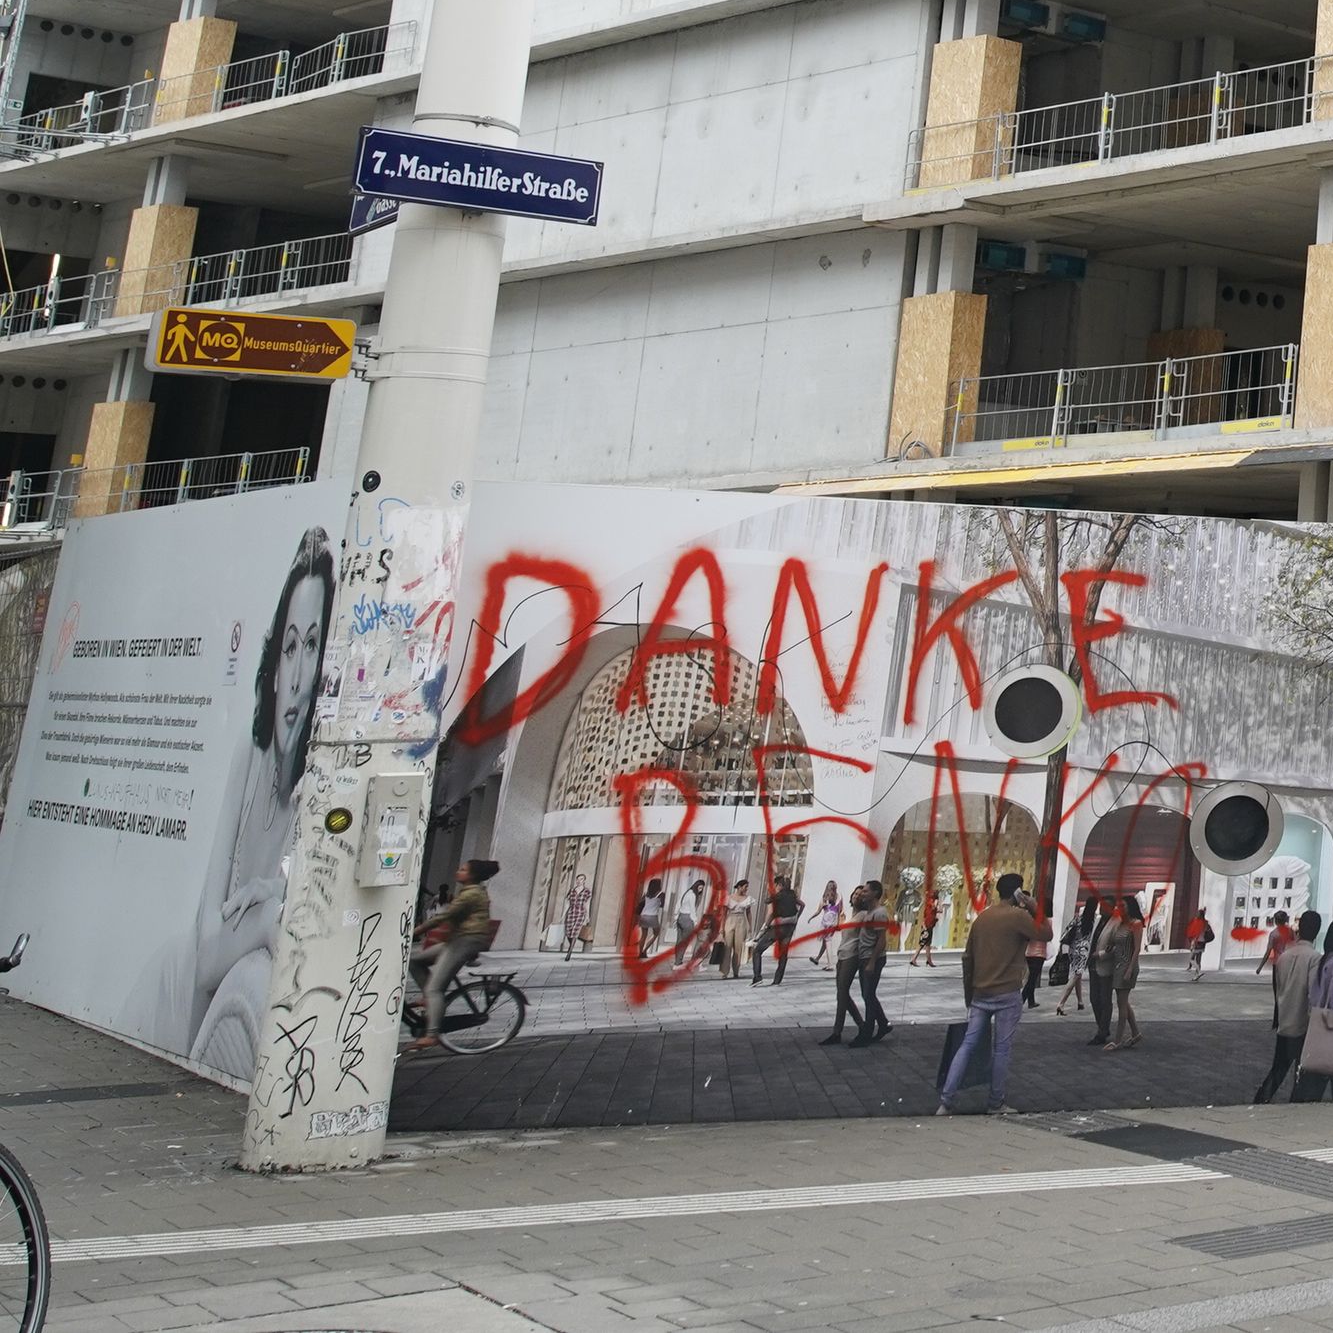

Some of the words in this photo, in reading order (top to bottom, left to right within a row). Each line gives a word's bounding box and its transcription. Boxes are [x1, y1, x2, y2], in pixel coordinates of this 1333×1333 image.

[397, 154, 522, 193] Mariahilfer
[522, 172, 589, 202] Straße
[201, 331, 239, 349] MQ
[243, 336, 341, 355] MuseumsQuartier
[73, 638, 100, 658] GEBOREN
[100, 638, 108, 657] IN
[109, 638, 127, 657] WIEN.
[129, 638, 161, 657] GEFEIERT
[161, 638, 168, 657] IN
[168, 638, 183, 657] DER
[183, 637, 202, 657] WELT.
[455, 546, 1180, 747] DANKE
[27, 799, 43, 817] HIER
[42, 802, 75, 823] ENTSTEHT
[74, 806, 90, 825] EINE
[89, 808, 127, 830] HOMMAGE
[126, 812, 137, 832] AN
[136, 814, 157, 835] HEDY
[155, 817, 187, 841] LAMARR.
